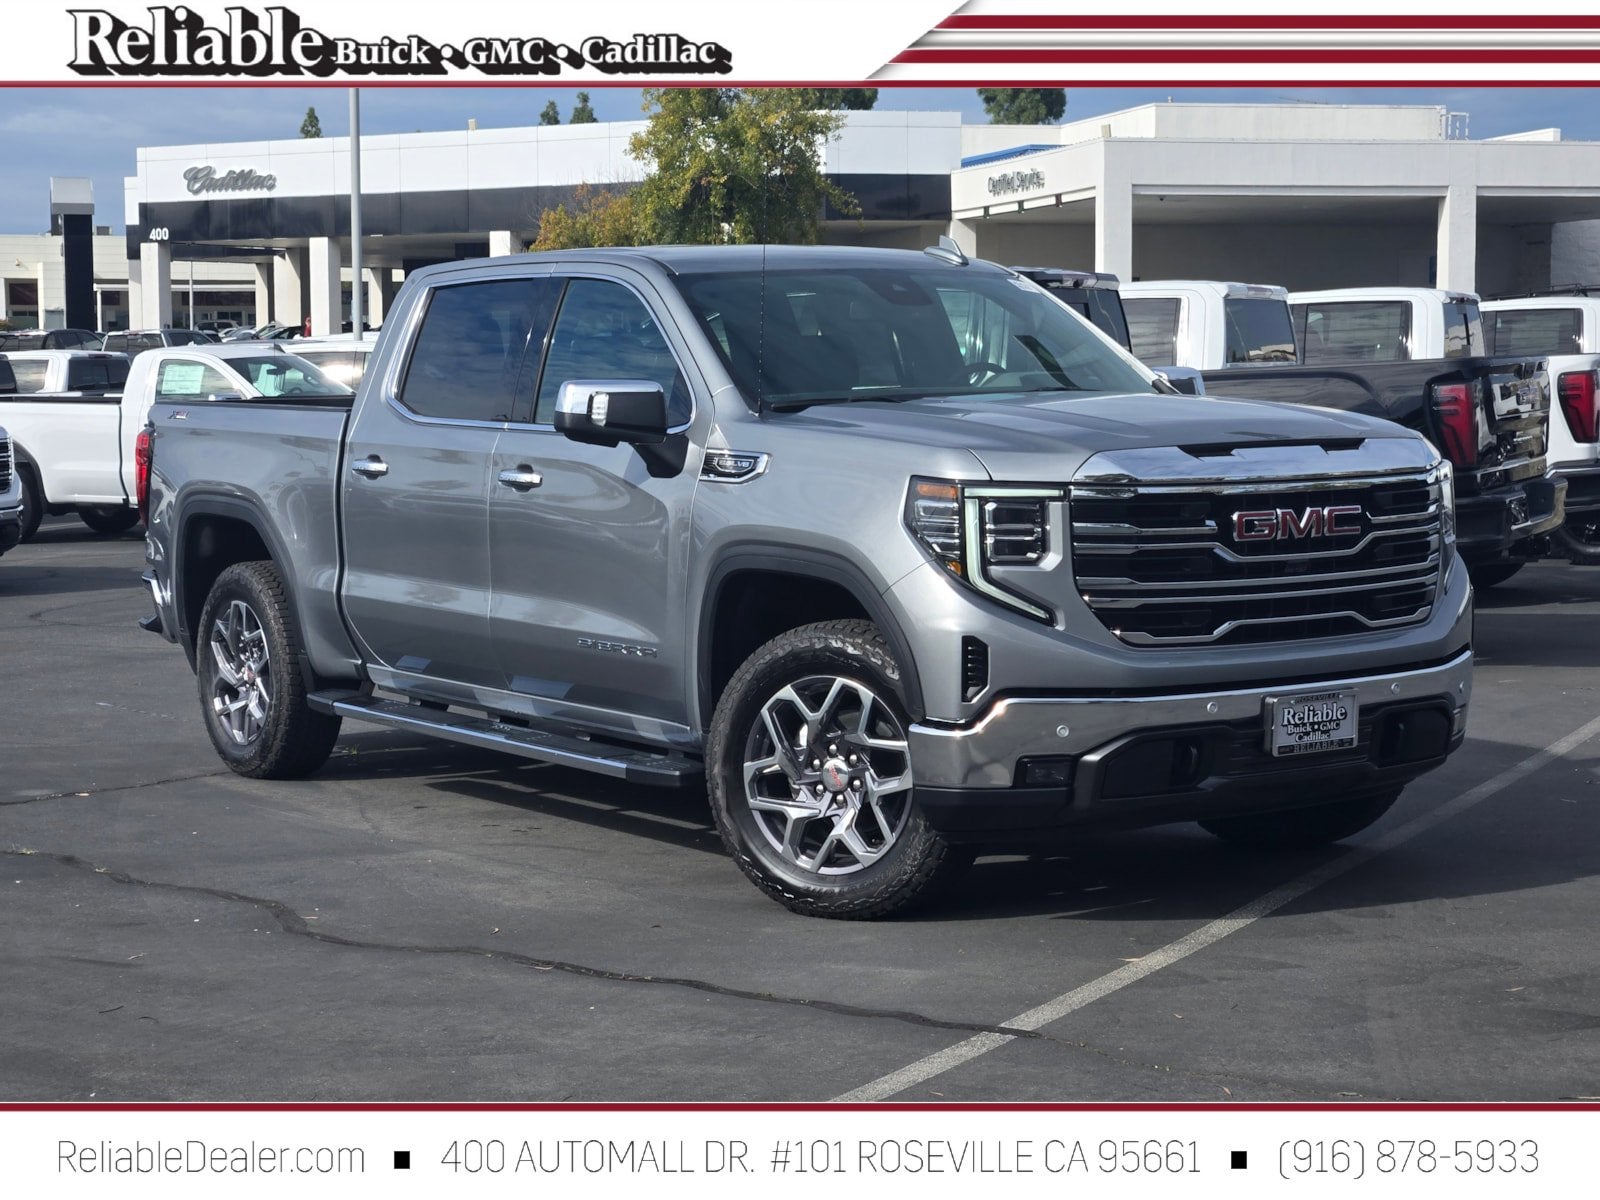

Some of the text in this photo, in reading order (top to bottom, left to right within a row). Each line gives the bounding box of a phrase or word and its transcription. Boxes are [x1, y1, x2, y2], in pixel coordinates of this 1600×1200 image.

[183, 166, 277, 195] Cadillac
[149, 228, 169, 240] 400
[1231, 505, 1361, 541] GMC
[1281, 702, 1348, 727] Reliable
[1287, 720, 1340, 734] Buick GMC
[1295, 731, 1330, 742] Cadillac
[1294, 740, 1340, 753] RELIABLE
